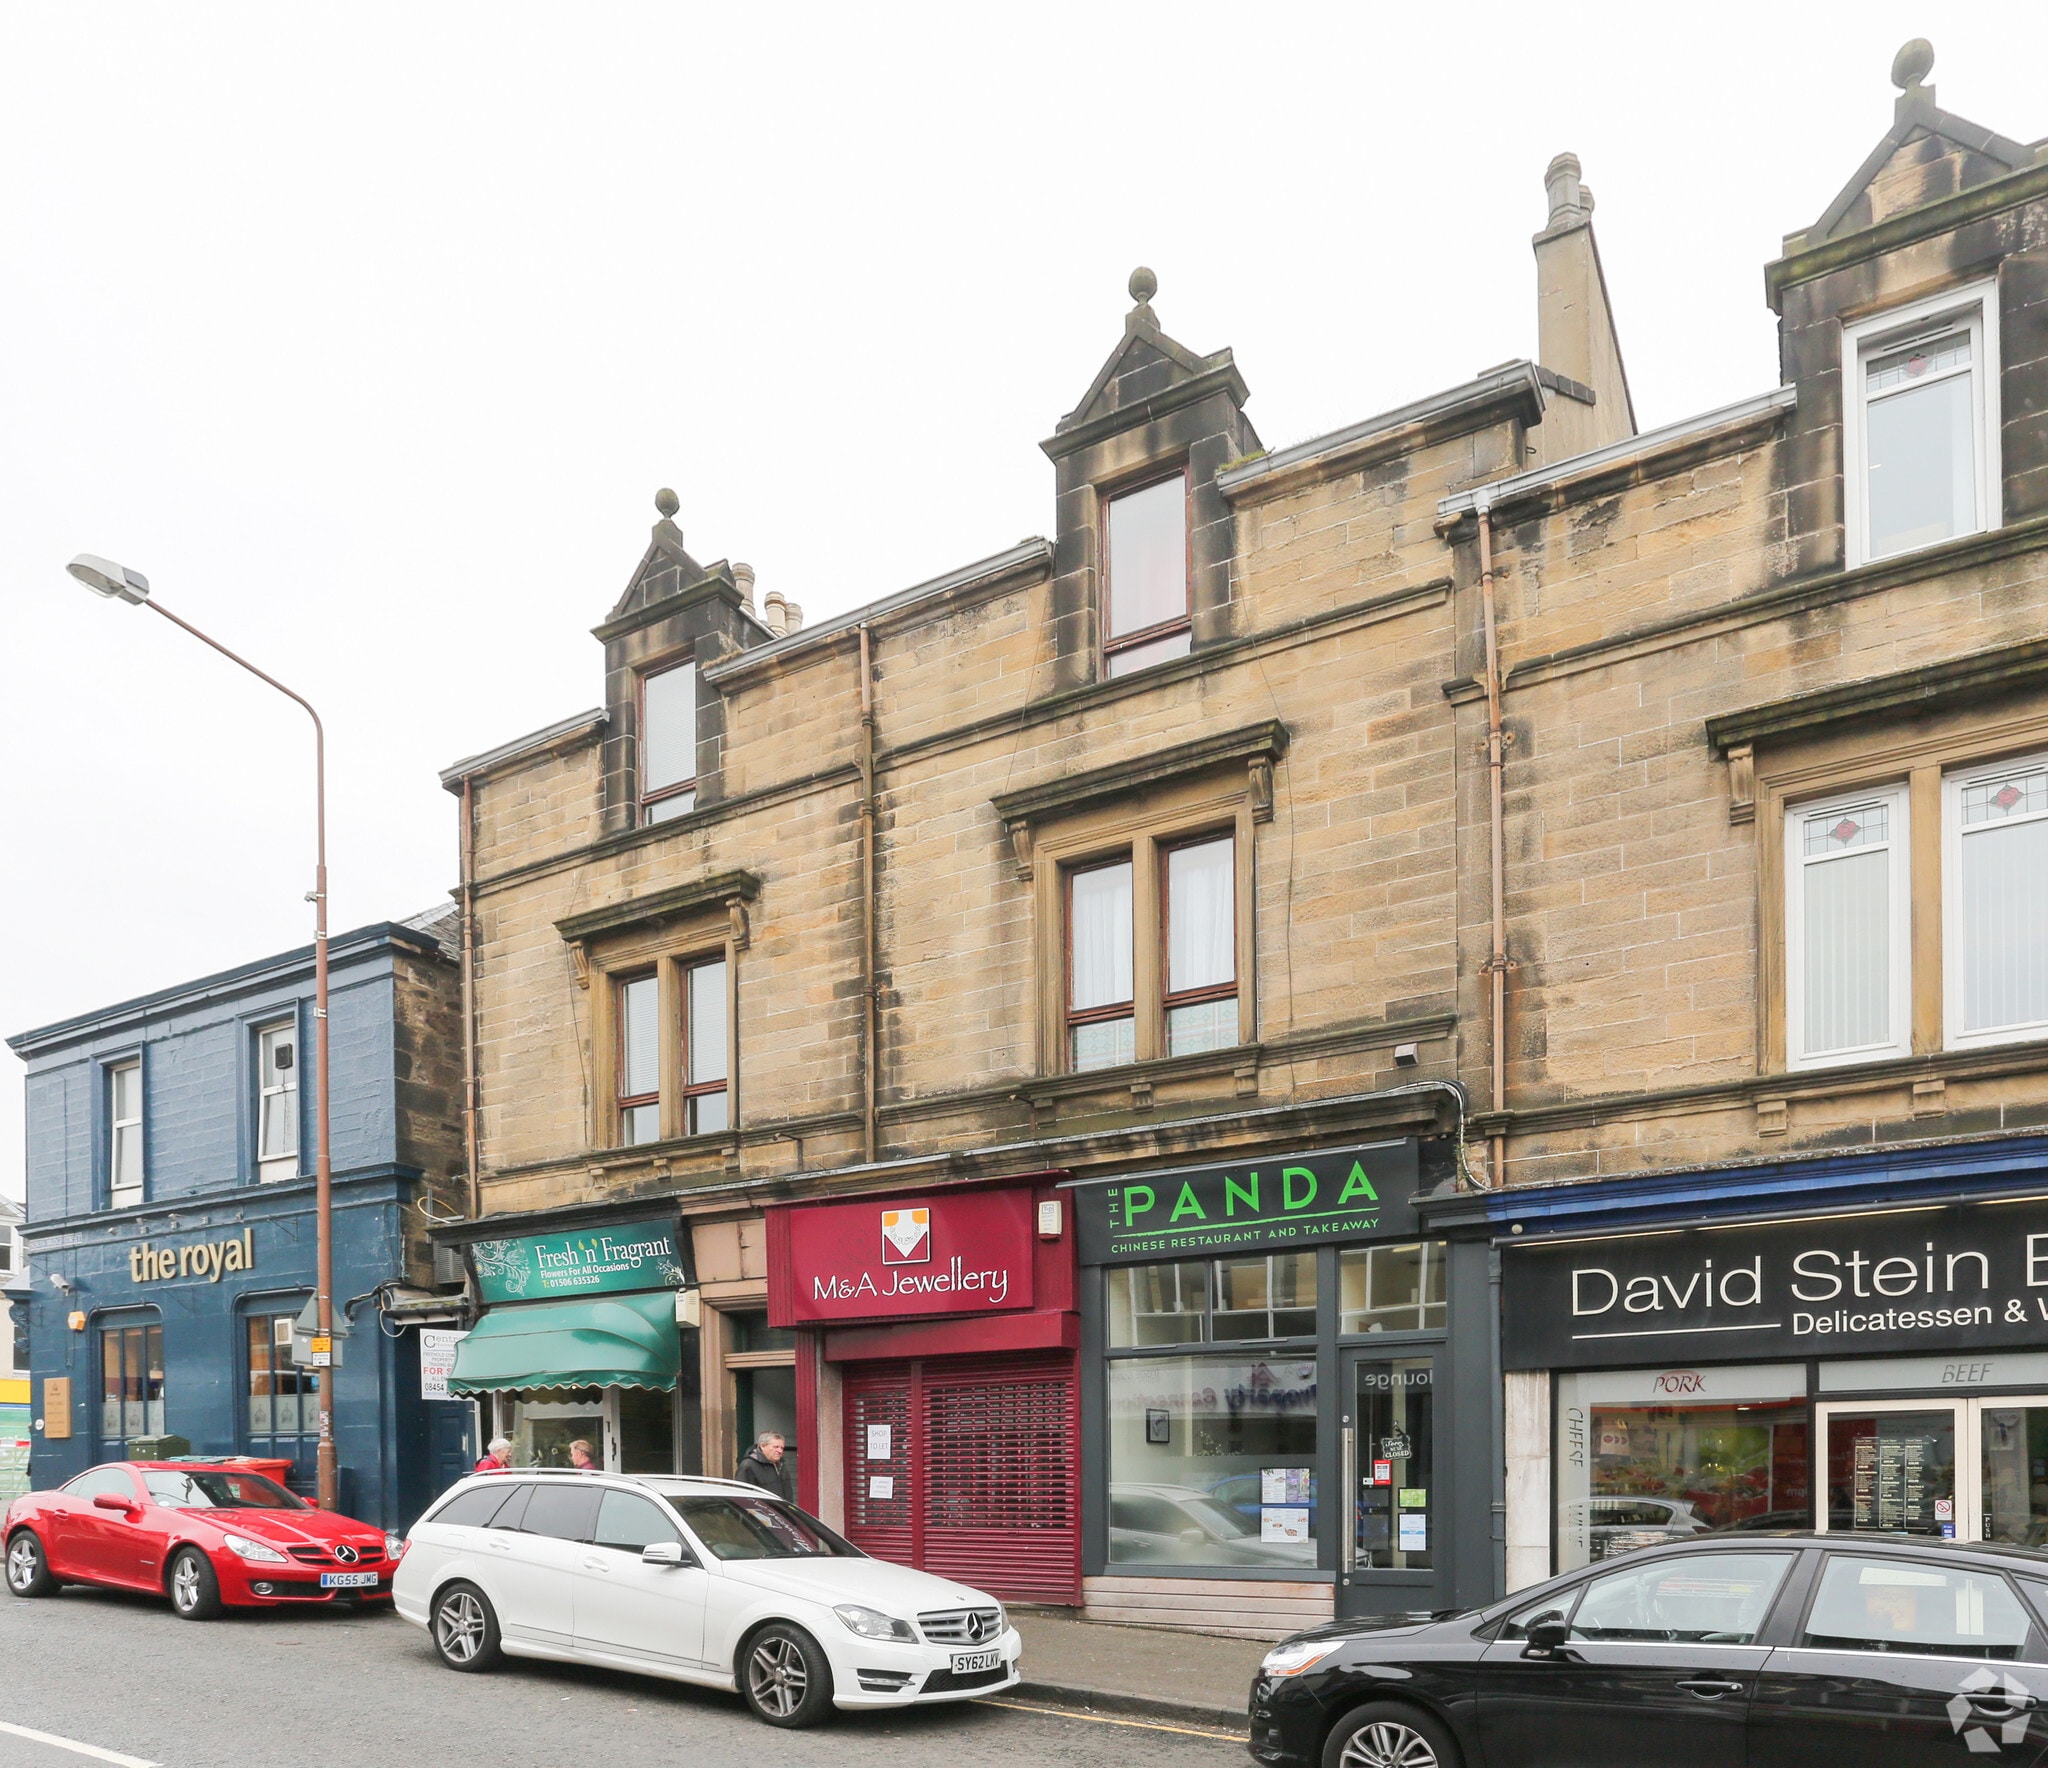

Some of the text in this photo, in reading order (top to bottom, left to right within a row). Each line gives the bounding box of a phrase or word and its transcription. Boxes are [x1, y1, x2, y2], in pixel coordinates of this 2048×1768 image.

[1123, 1160, 1379, 1227] PANDA
[1107, 1187, 1120, 1229] THE
[1111, 1218, 1380, 1254] CHINESE RESTAURANT AND TAKEAWAY
[129, 1228, 253, 1283] the royal
[535, 1241, 579, 1269] Fresh
[600, 1237, 672, 1268] Fragrant
[540, 1263, 630, 1279] Flowers For All Occasions
[550, 1278, 572, 1288] 01506
[573, 1275, 600, 1286] 635326
[813, 1256, 1008, 1303] M&A Jewellery
[1572, 1255, 1761, 1316] David
[1791, 1242, 1990, 1302] Stein
[1793, 1303, 1993, 1336] Delicatessen
[2004, 1299, 2028, 1323] &
[423, 1367, 443, 1375] FOR
[1653, 1375, 1706, 1393] PORK
[1942, 1363, 1994, 1383] BEEF
[1385, 1450, 1410, 1458] CLOSED
[330, 1575, 358, 1585] KG55
[957, 1656, 984, 1671] SY62
